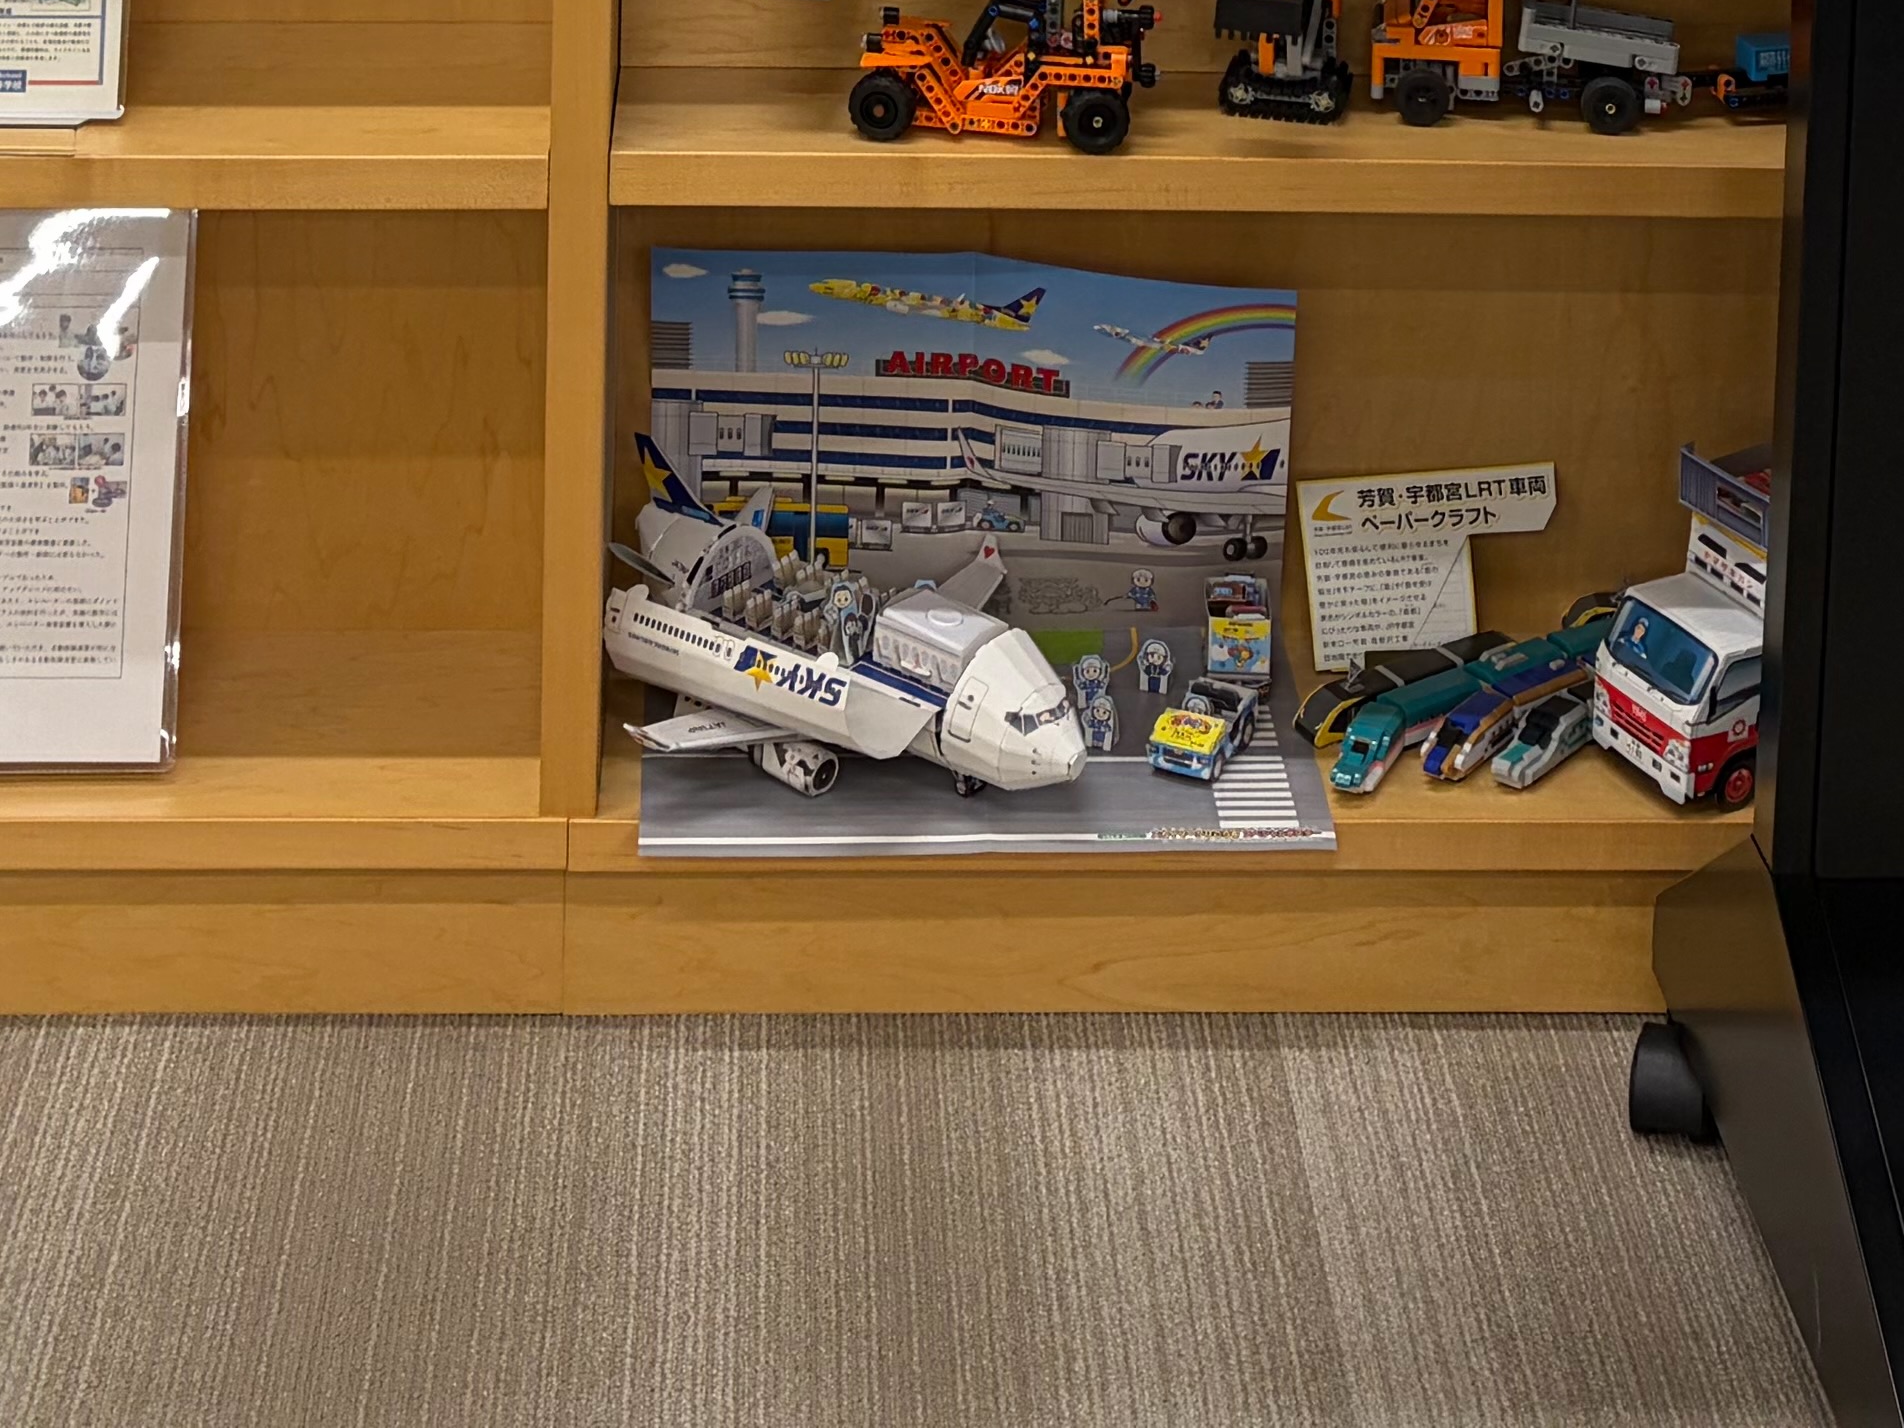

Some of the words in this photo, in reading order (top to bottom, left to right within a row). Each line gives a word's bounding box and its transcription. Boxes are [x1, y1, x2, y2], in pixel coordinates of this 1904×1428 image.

[886, 349, 1062, 393] AIRPORT
[1179, 450, 1239, 483] SKY
[1356, 474, 1547, 510] 芳賀・宇都宮LRT車両
[1361, 505, 1497, 532] ペーパークラフト
[776, 662, 848, 707] SKY
